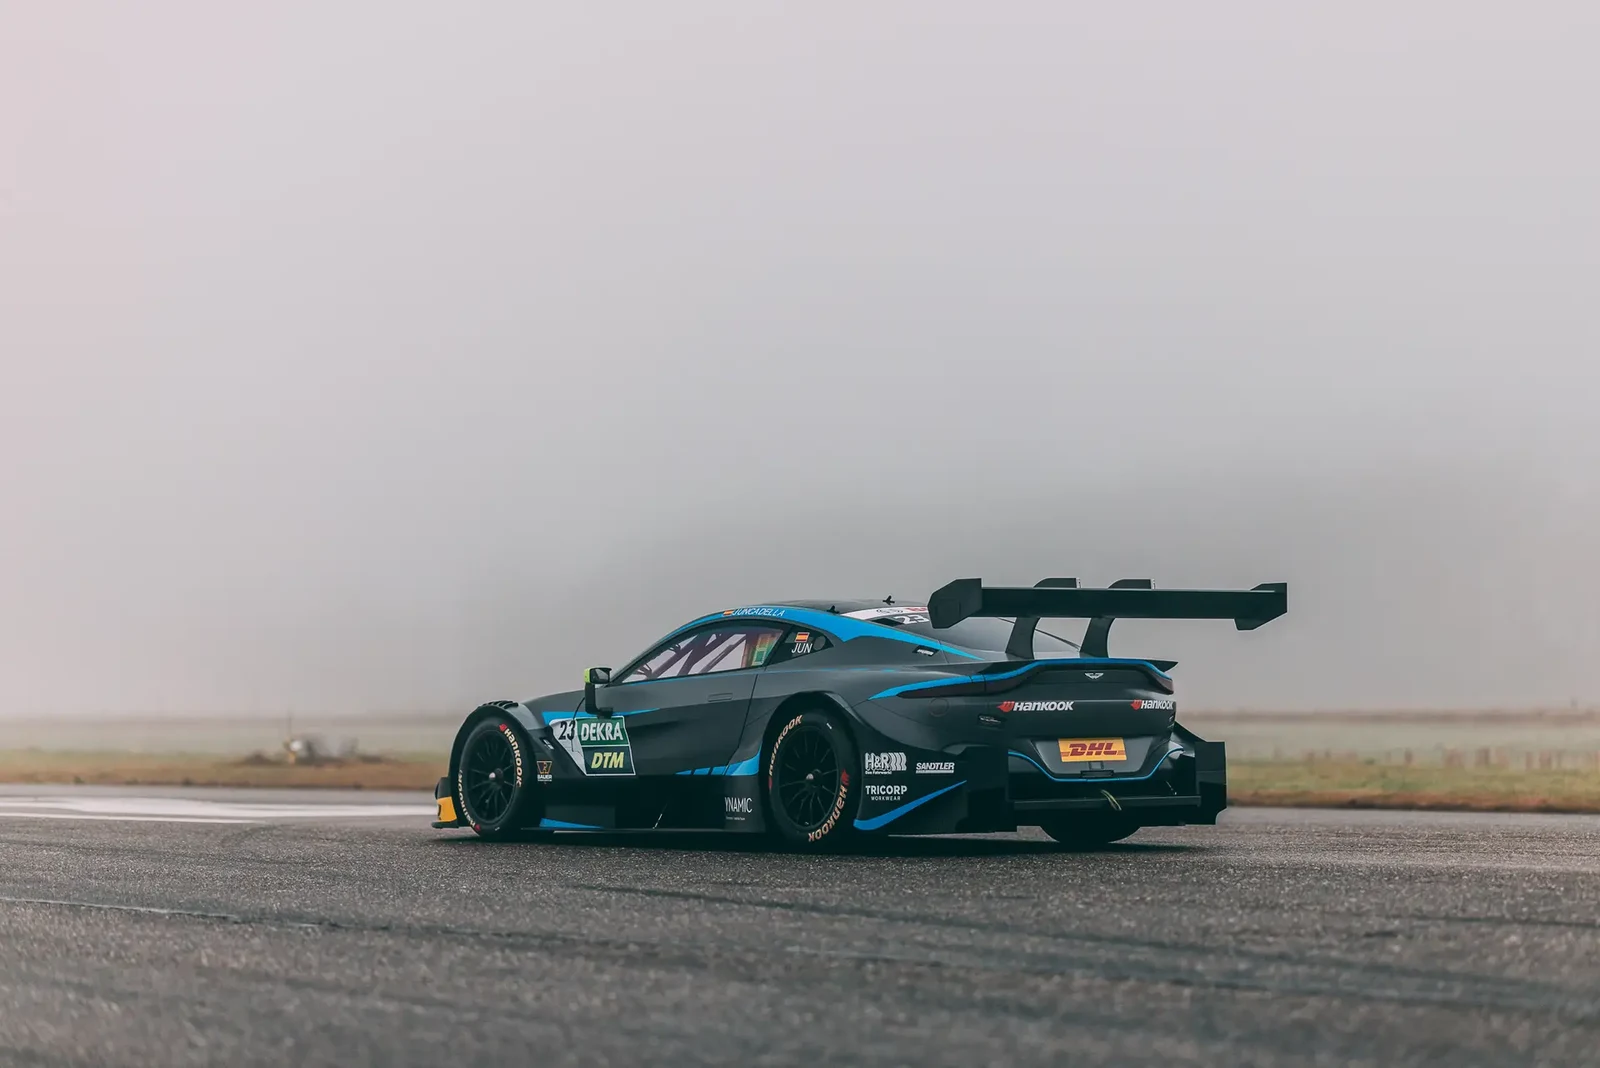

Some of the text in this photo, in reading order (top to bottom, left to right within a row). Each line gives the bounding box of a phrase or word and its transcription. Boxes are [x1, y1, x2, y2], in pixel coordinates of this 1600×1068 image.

[732, 607, 785, 617] JUNCADELLA
[893, 614, 930, 625] 23
[791, 643, 813, 653] JUN
[558, 720, 575, 740] 23
[581, 722, 624, 741] DEKRA
[1069, 742, 1118, 756] DHL
[591, 752, 624, 768] DTM
[865, 752, 890, 770] H&R
[916, 762, 955, 770] SANDTLER
[865, 785, 907, 795] TRICORP
